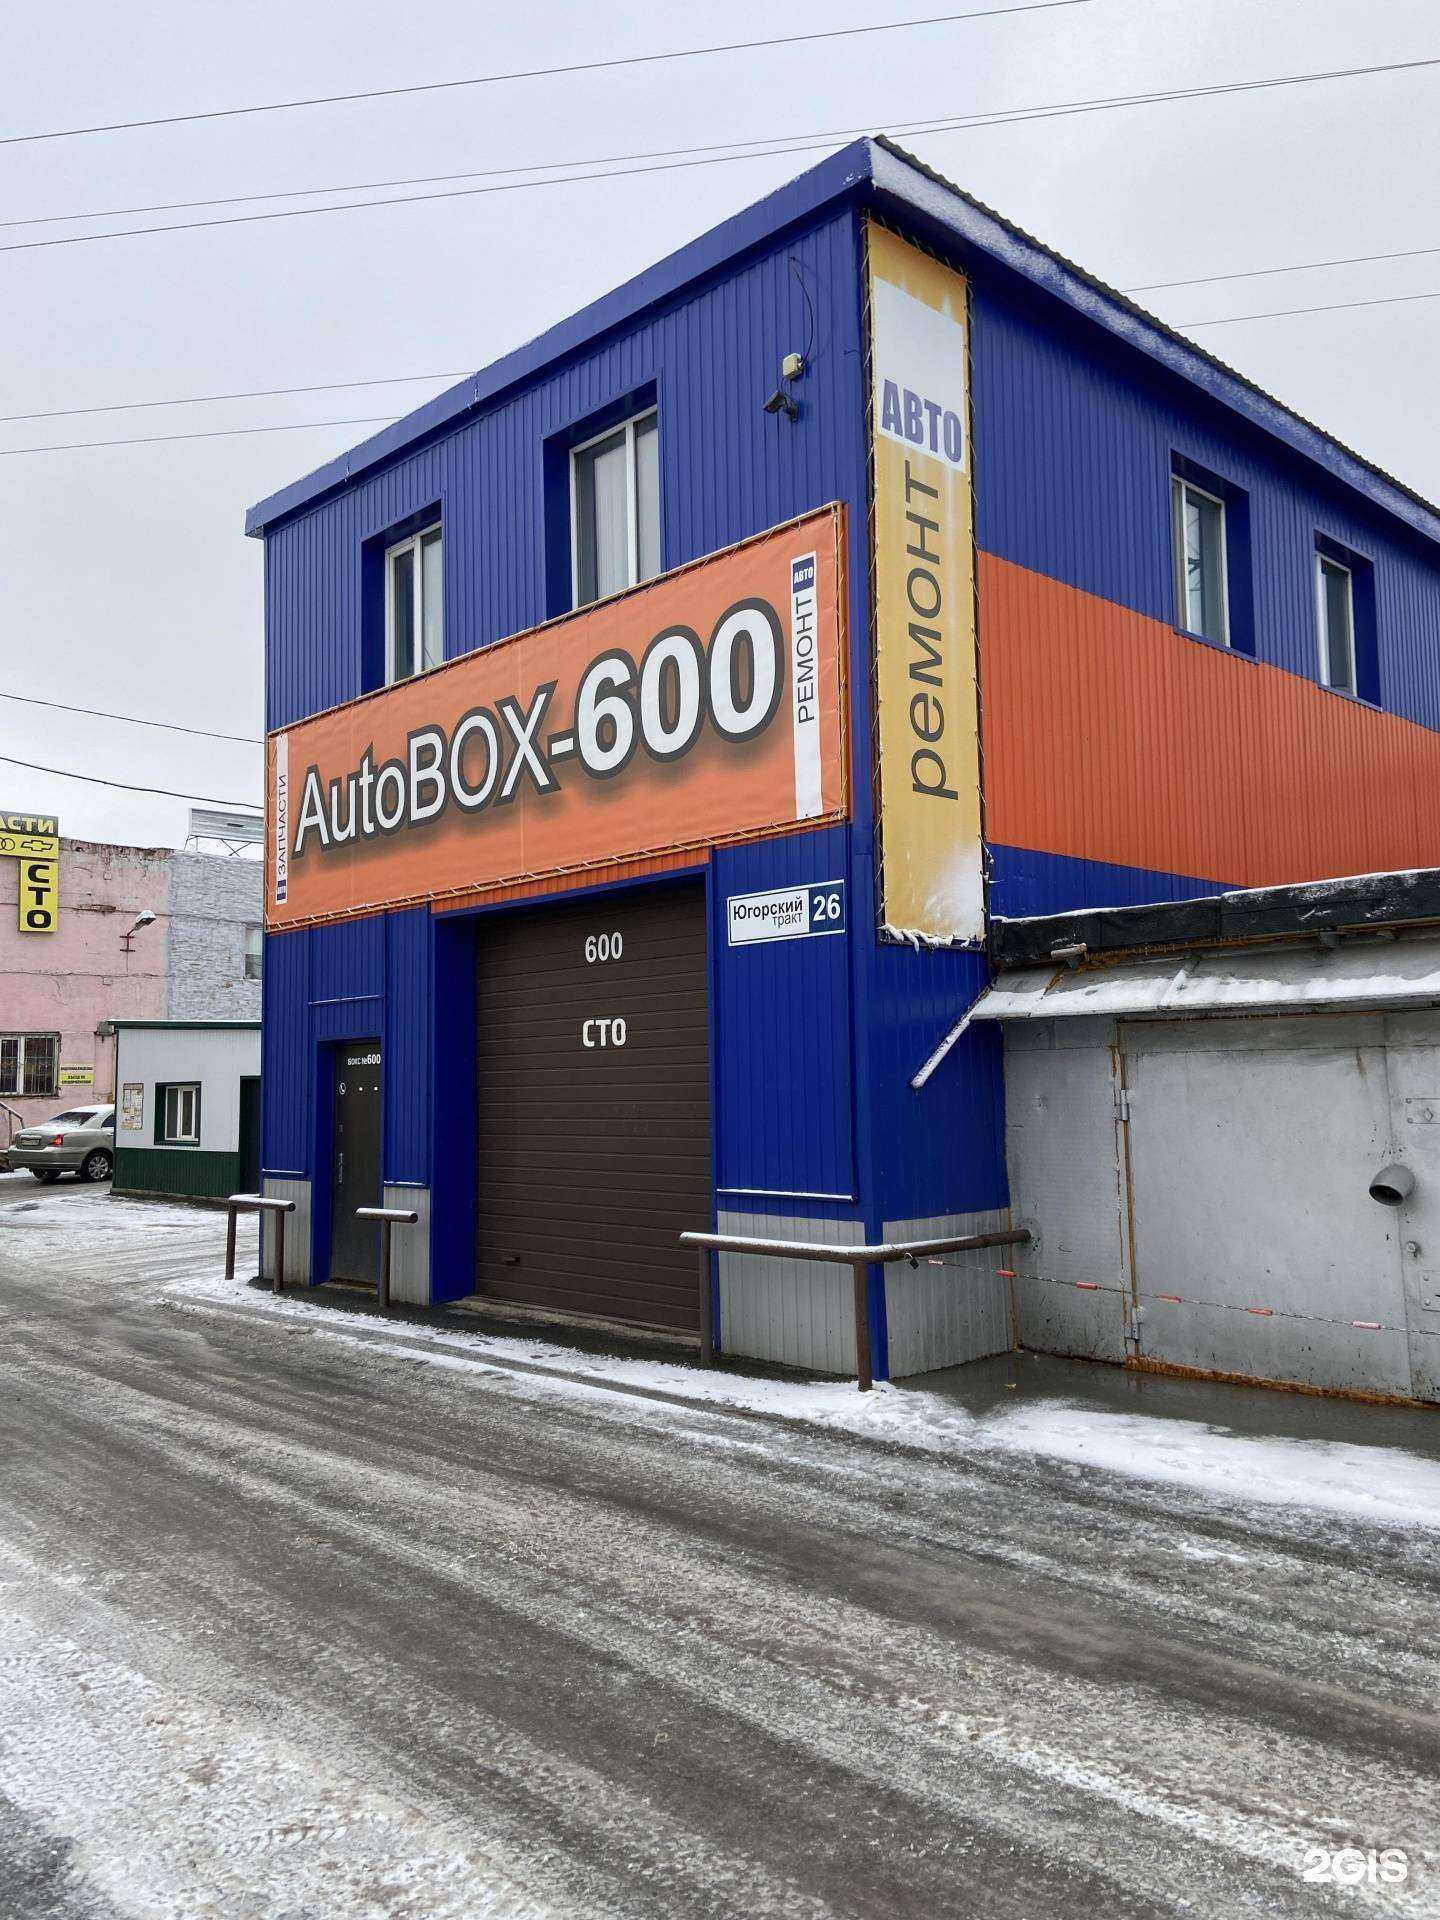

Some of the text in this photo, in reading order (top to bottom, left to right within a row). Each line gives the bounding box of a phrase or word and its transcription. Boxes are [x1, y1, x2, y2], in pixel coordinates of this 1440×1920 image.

[882, 379, 962, 463] АВТО
[793, 565, 814, 585] АВТО
[795, 596, 815, 725] РЕМОНТ
[904, 459, 959, 801] ремонт
[290, 600, 783, 857] AutoBOX-600
[278, 774, 287, 876] ЗАПЧАСТИ
[26, 863, 52, 929] СТО
[733, 893, 841, 921] Югорский 26
[772, 911, 803, 928] тракт
[585, 931, 623, 963] 600
[582, 1018, 627, 1048] СТО
